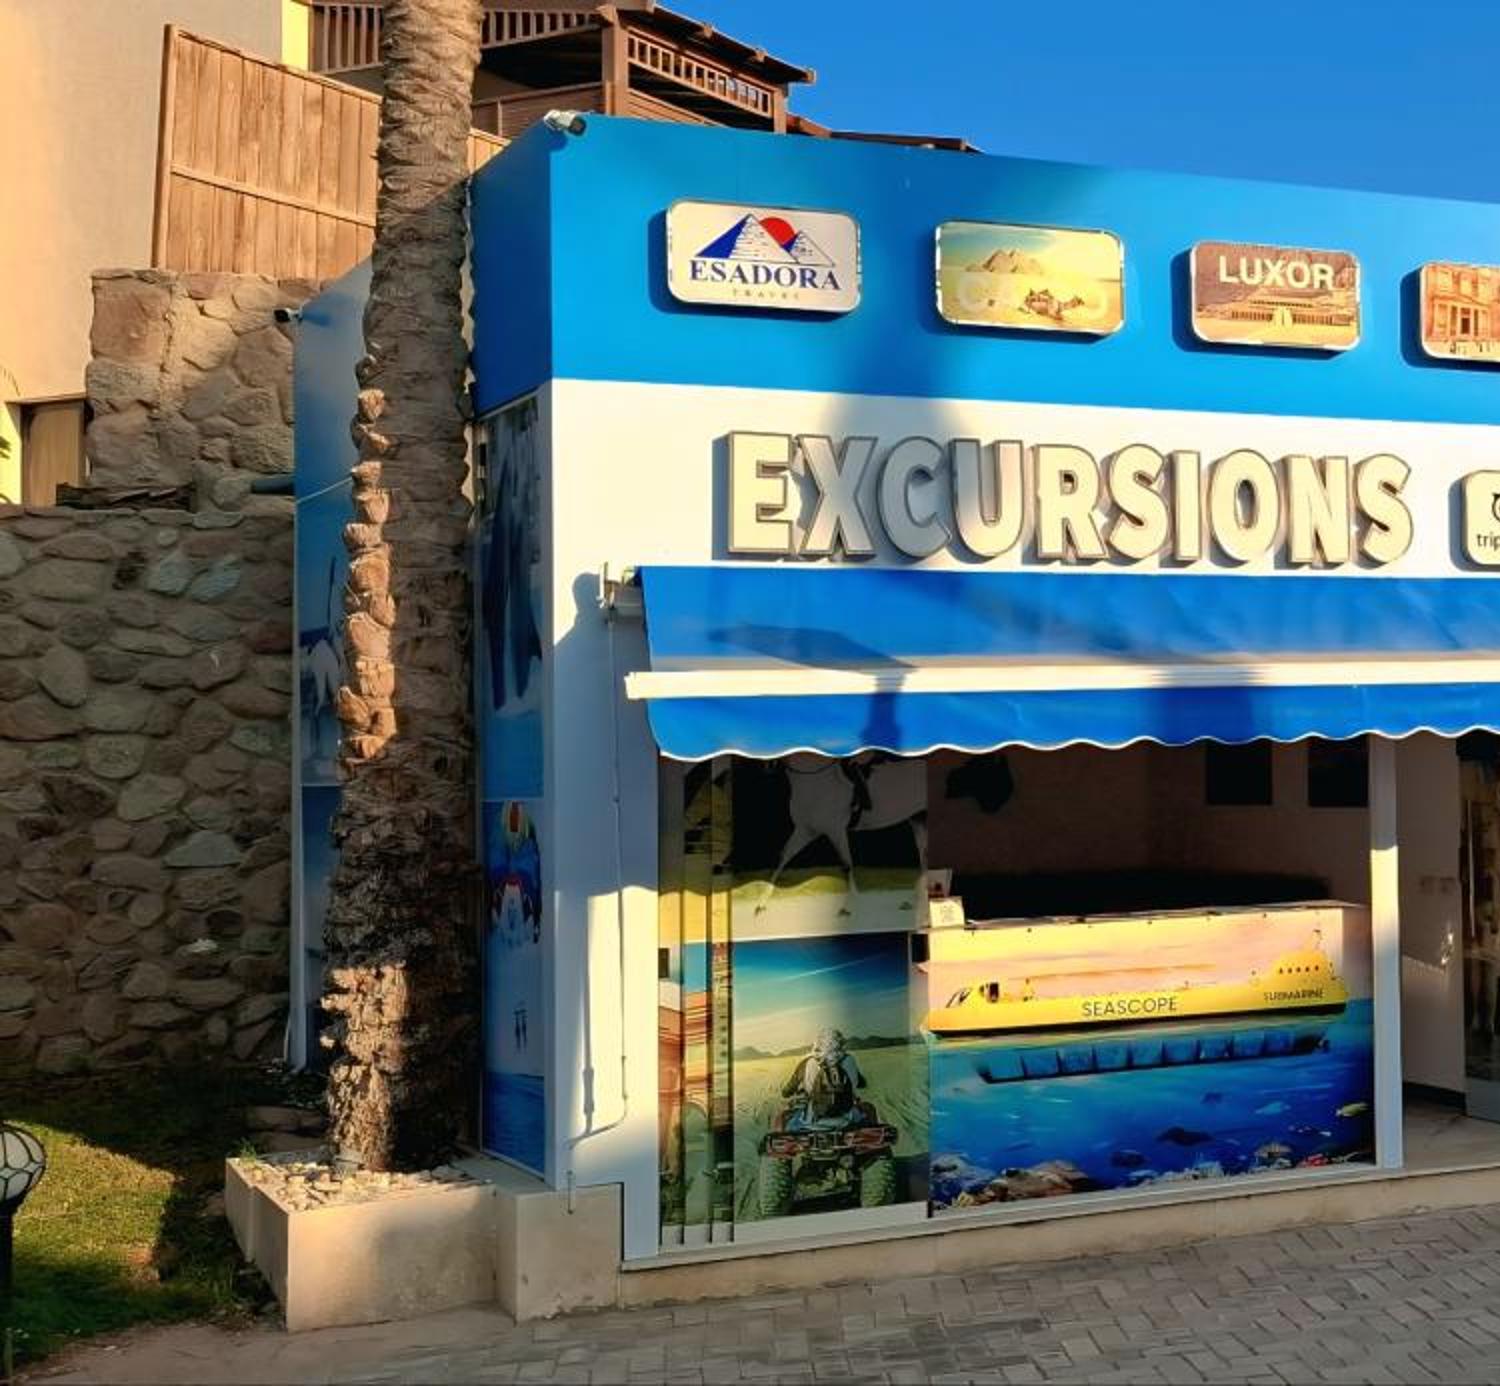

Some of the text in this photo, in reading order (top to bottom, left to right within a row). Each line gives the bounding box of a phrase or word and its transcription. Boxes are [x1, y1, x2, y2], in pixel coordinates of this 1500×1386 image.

[689, 260, 841, 290] ESADORA
[1219, 255, 1334, 291] LUXOR
[724, 430, 1415, 567] EXCURSIONS
[1081, 995, 1178, 1018] SEASCOPE
